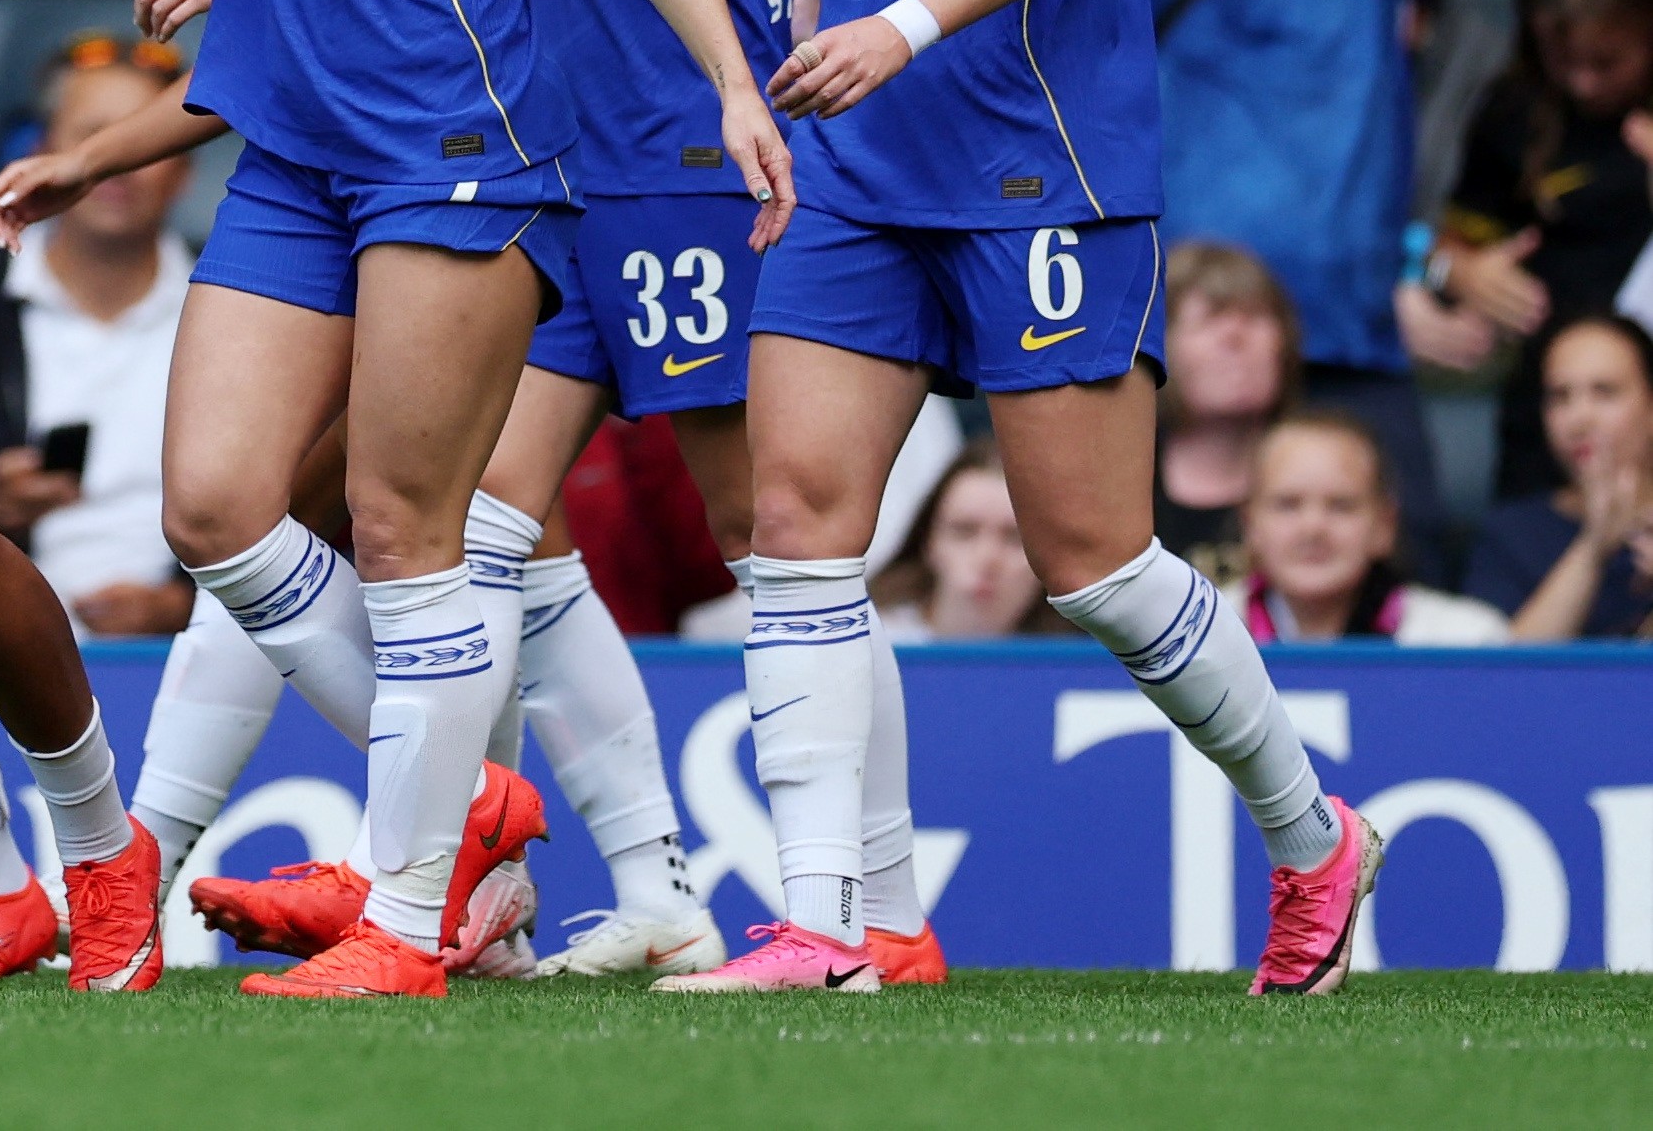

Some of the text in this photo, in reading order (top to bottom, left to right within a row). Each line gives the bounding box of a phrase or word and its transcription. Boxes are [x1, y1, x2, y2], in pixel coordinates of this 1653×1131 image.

[622, 247, 729, 348] 33
[1028, 225, 1084, 321] 6
[839, 876, 853, 929] ESIGN
